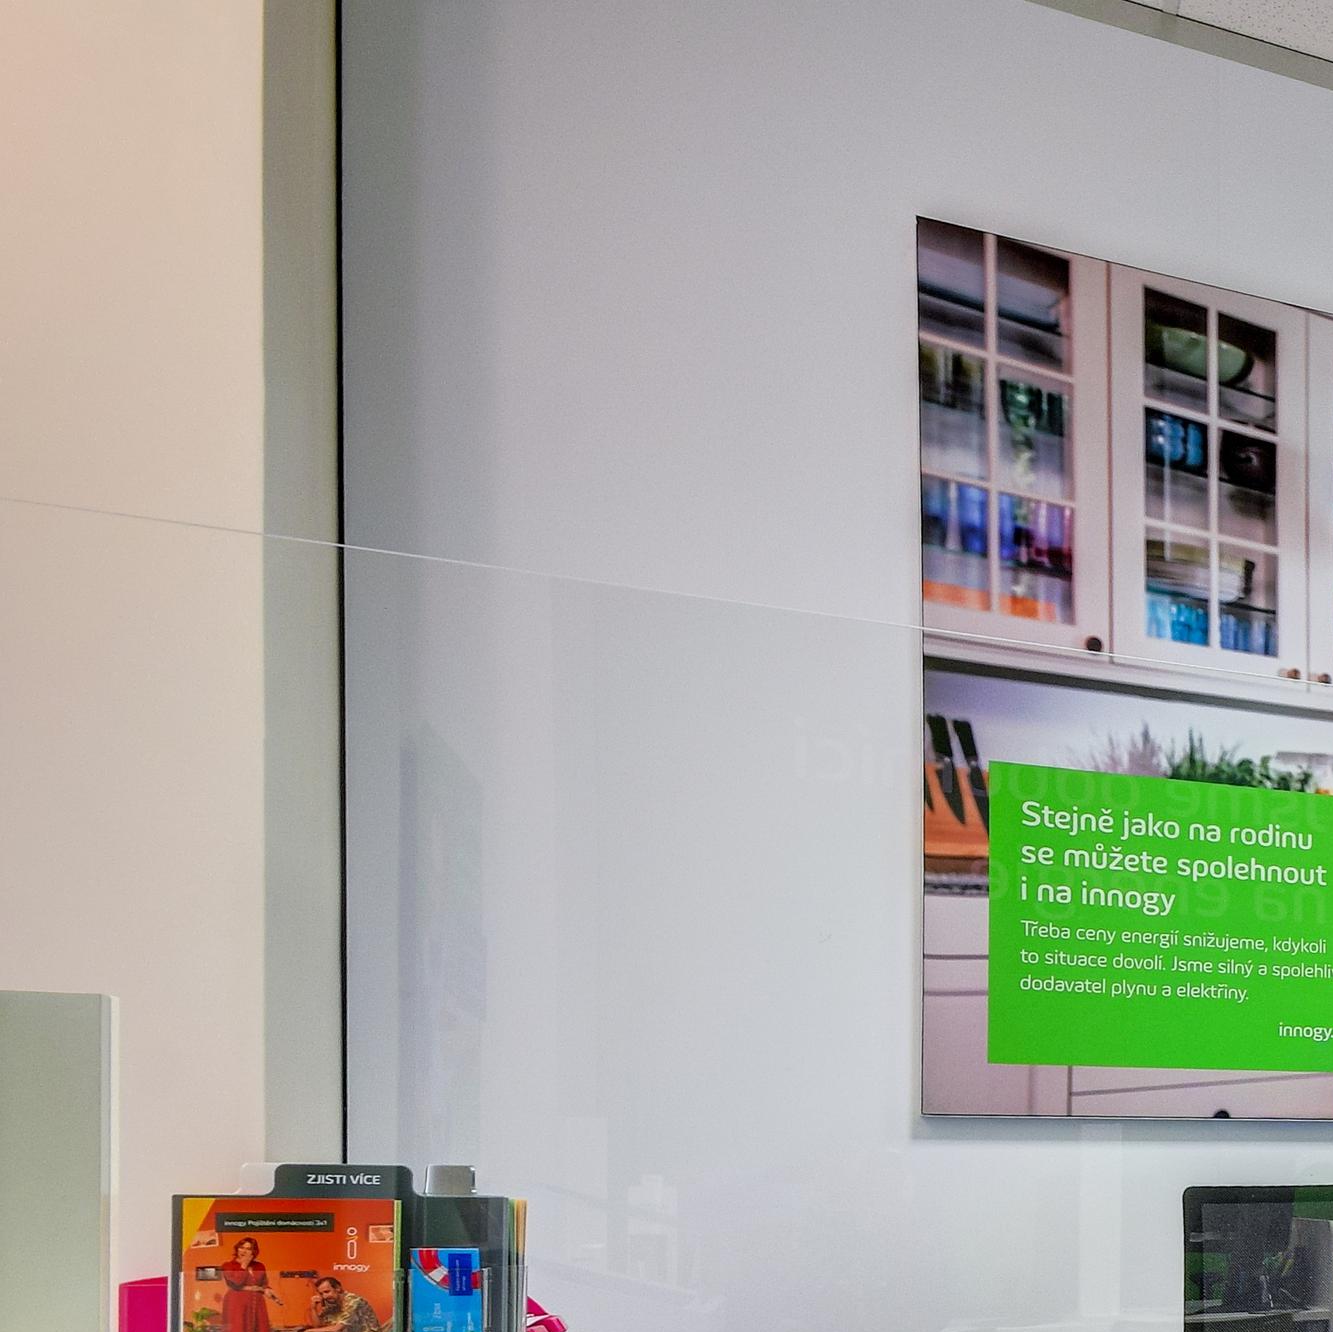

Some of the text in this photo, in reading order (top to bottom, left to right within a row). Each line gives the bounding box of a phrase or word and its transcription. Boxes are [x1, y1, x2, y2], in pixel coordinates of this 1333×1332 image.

[1021, 800, 1313, 850] Stejně jako na rodinu
[1021, 844, 1327, 886] se můžete spolehnout
[1021, 876, 1176, 916] i na innogy
[1020, 920, 1326, 956] Třeba ceny energií snižujeme, kdykoli
[1020, 949, 1039, 964] to
[1044, 950, 1107, 968] situace
[1112, 953, 1165, 971] dovolí.
[1171, 956, 1213, 973] Jsme
[1217, 958, 1253, 977] silný
[1258, 964, 1267, 976] a
[1020, 975, 1249, 1003] dodavatel plynu a elektřiny.
[307, 1172, 381, 1185] ZJISTI VÍCE
[333, 1262, 370, 1272] innogy
